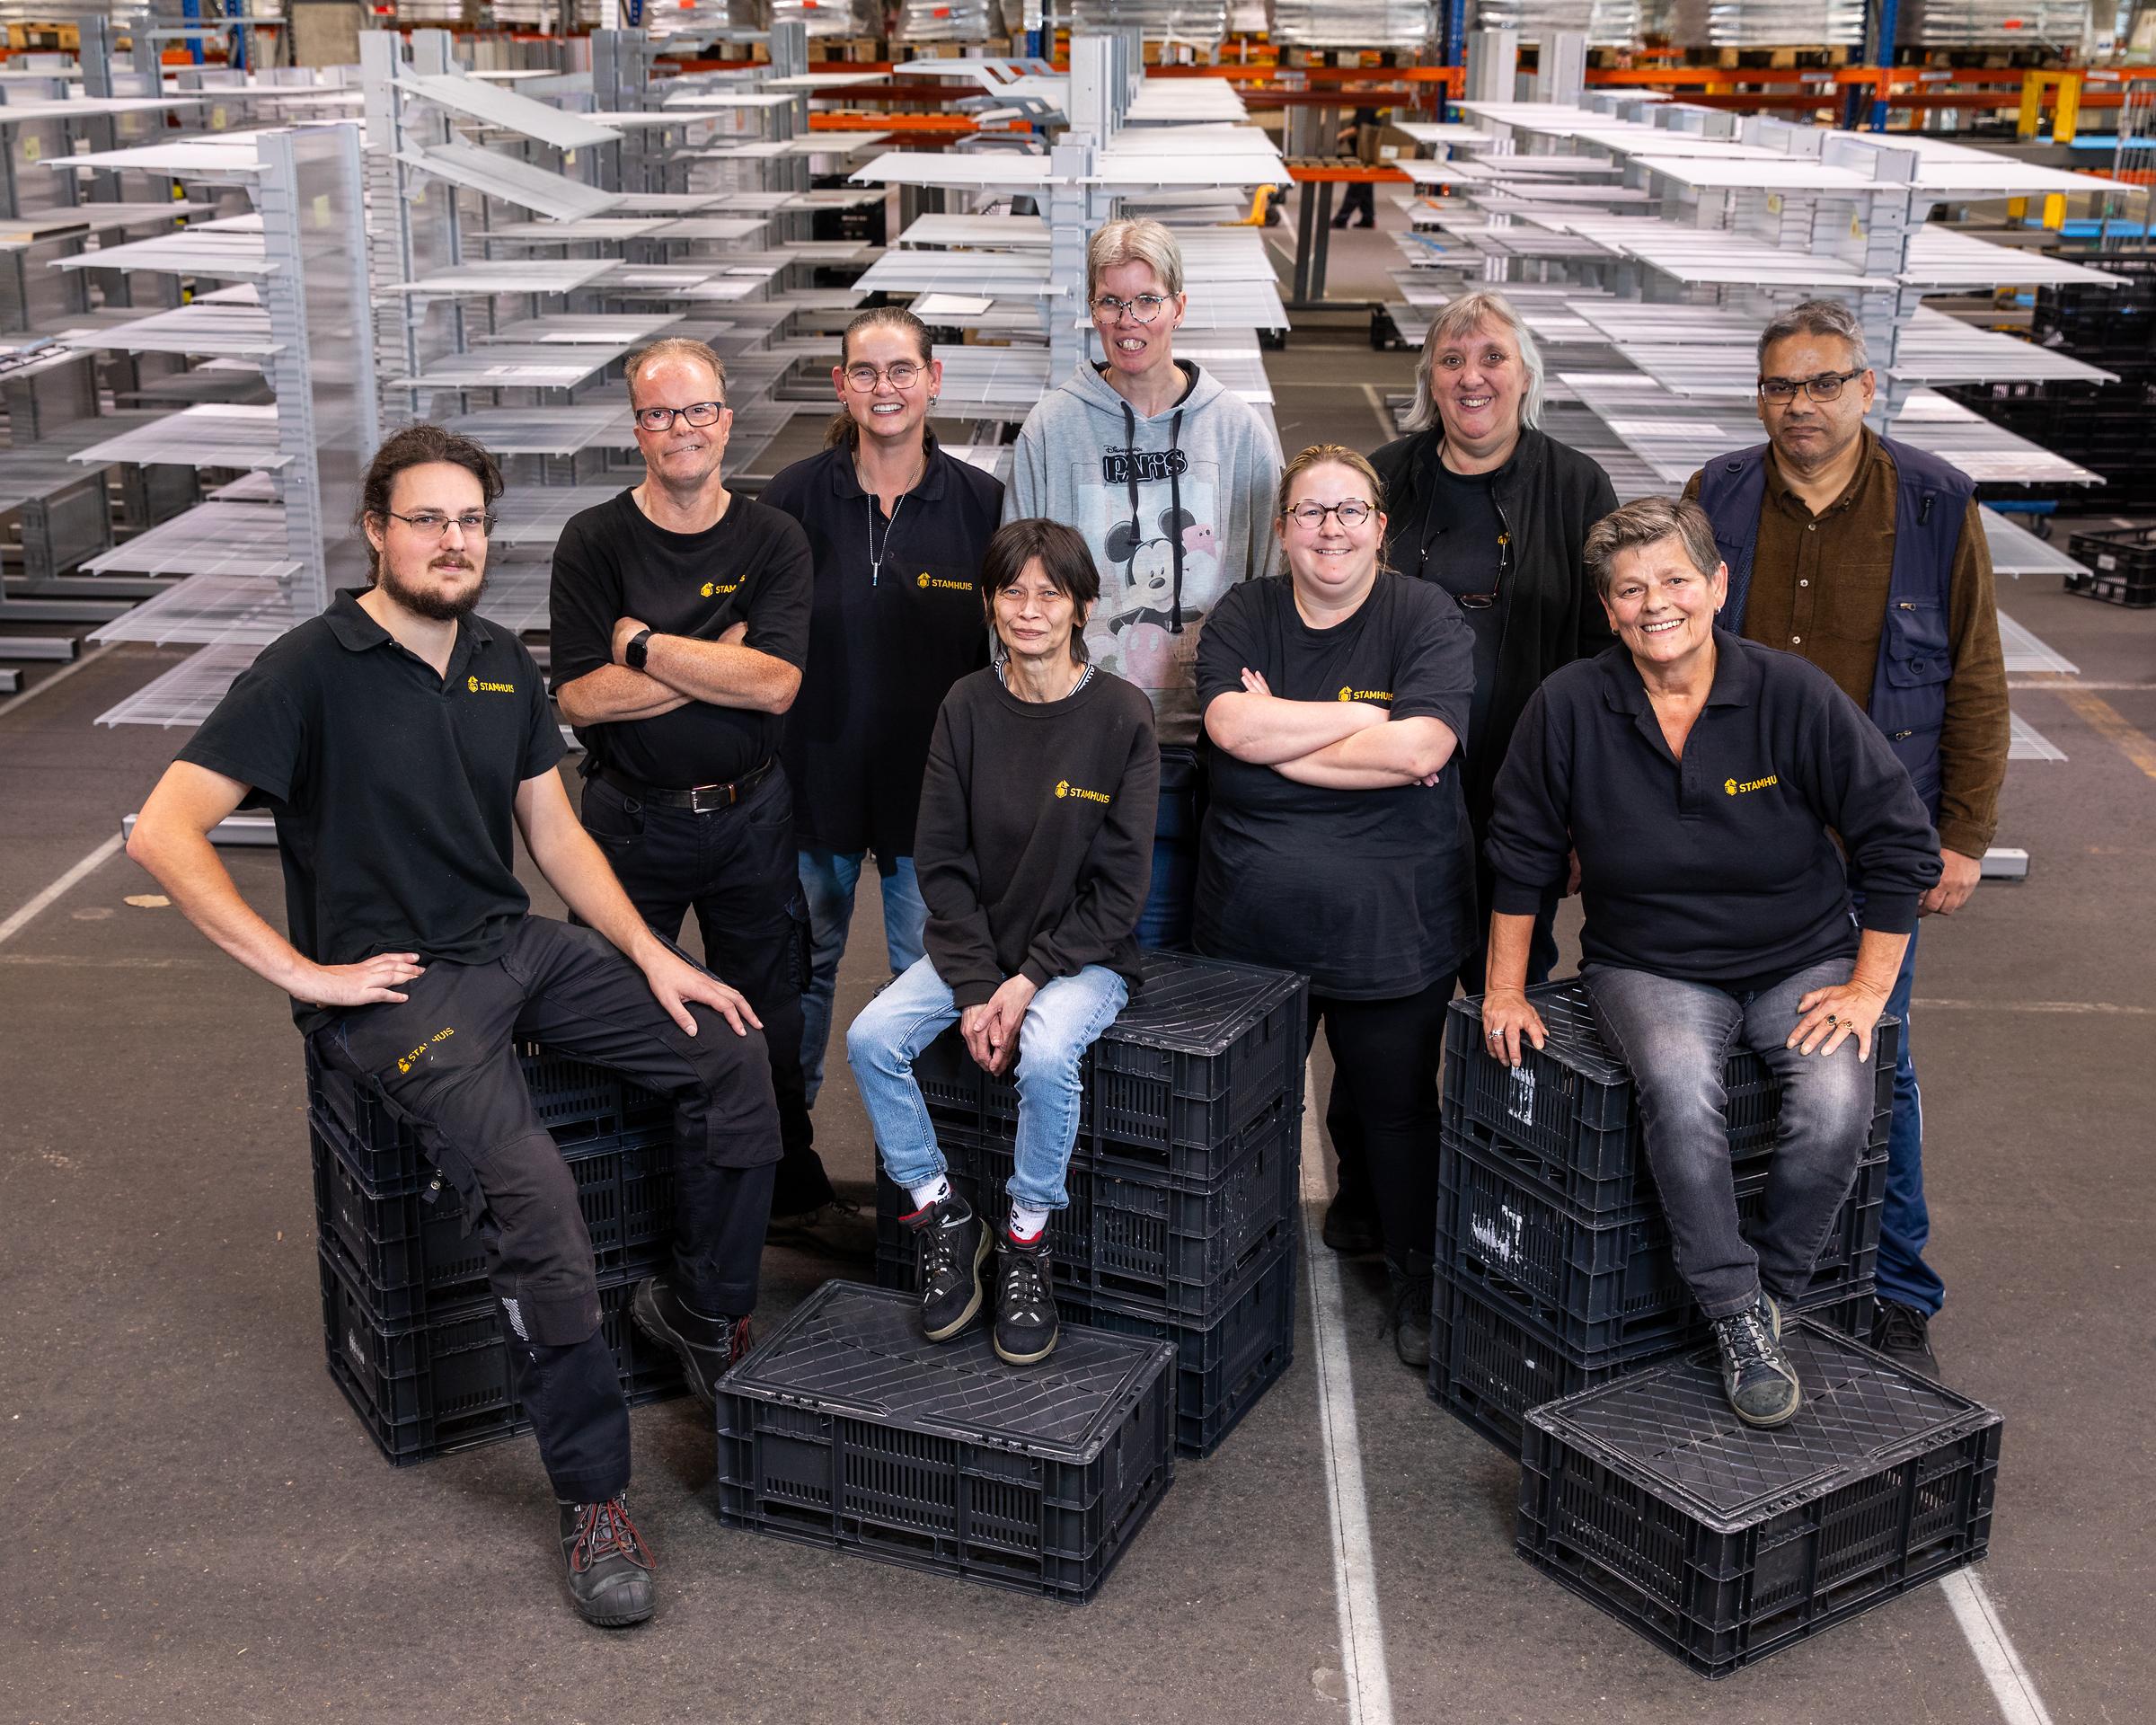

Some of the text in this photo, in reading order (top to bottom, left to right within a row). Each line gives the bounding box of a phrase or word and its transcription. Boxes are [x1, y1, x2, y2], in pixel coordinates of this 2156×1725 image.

[932, 579, 973, 590] STAMHUIS
[1738, 774, 1778, 793] STAMHU
[1069, 787, 1110, 804] STAMHUIS
